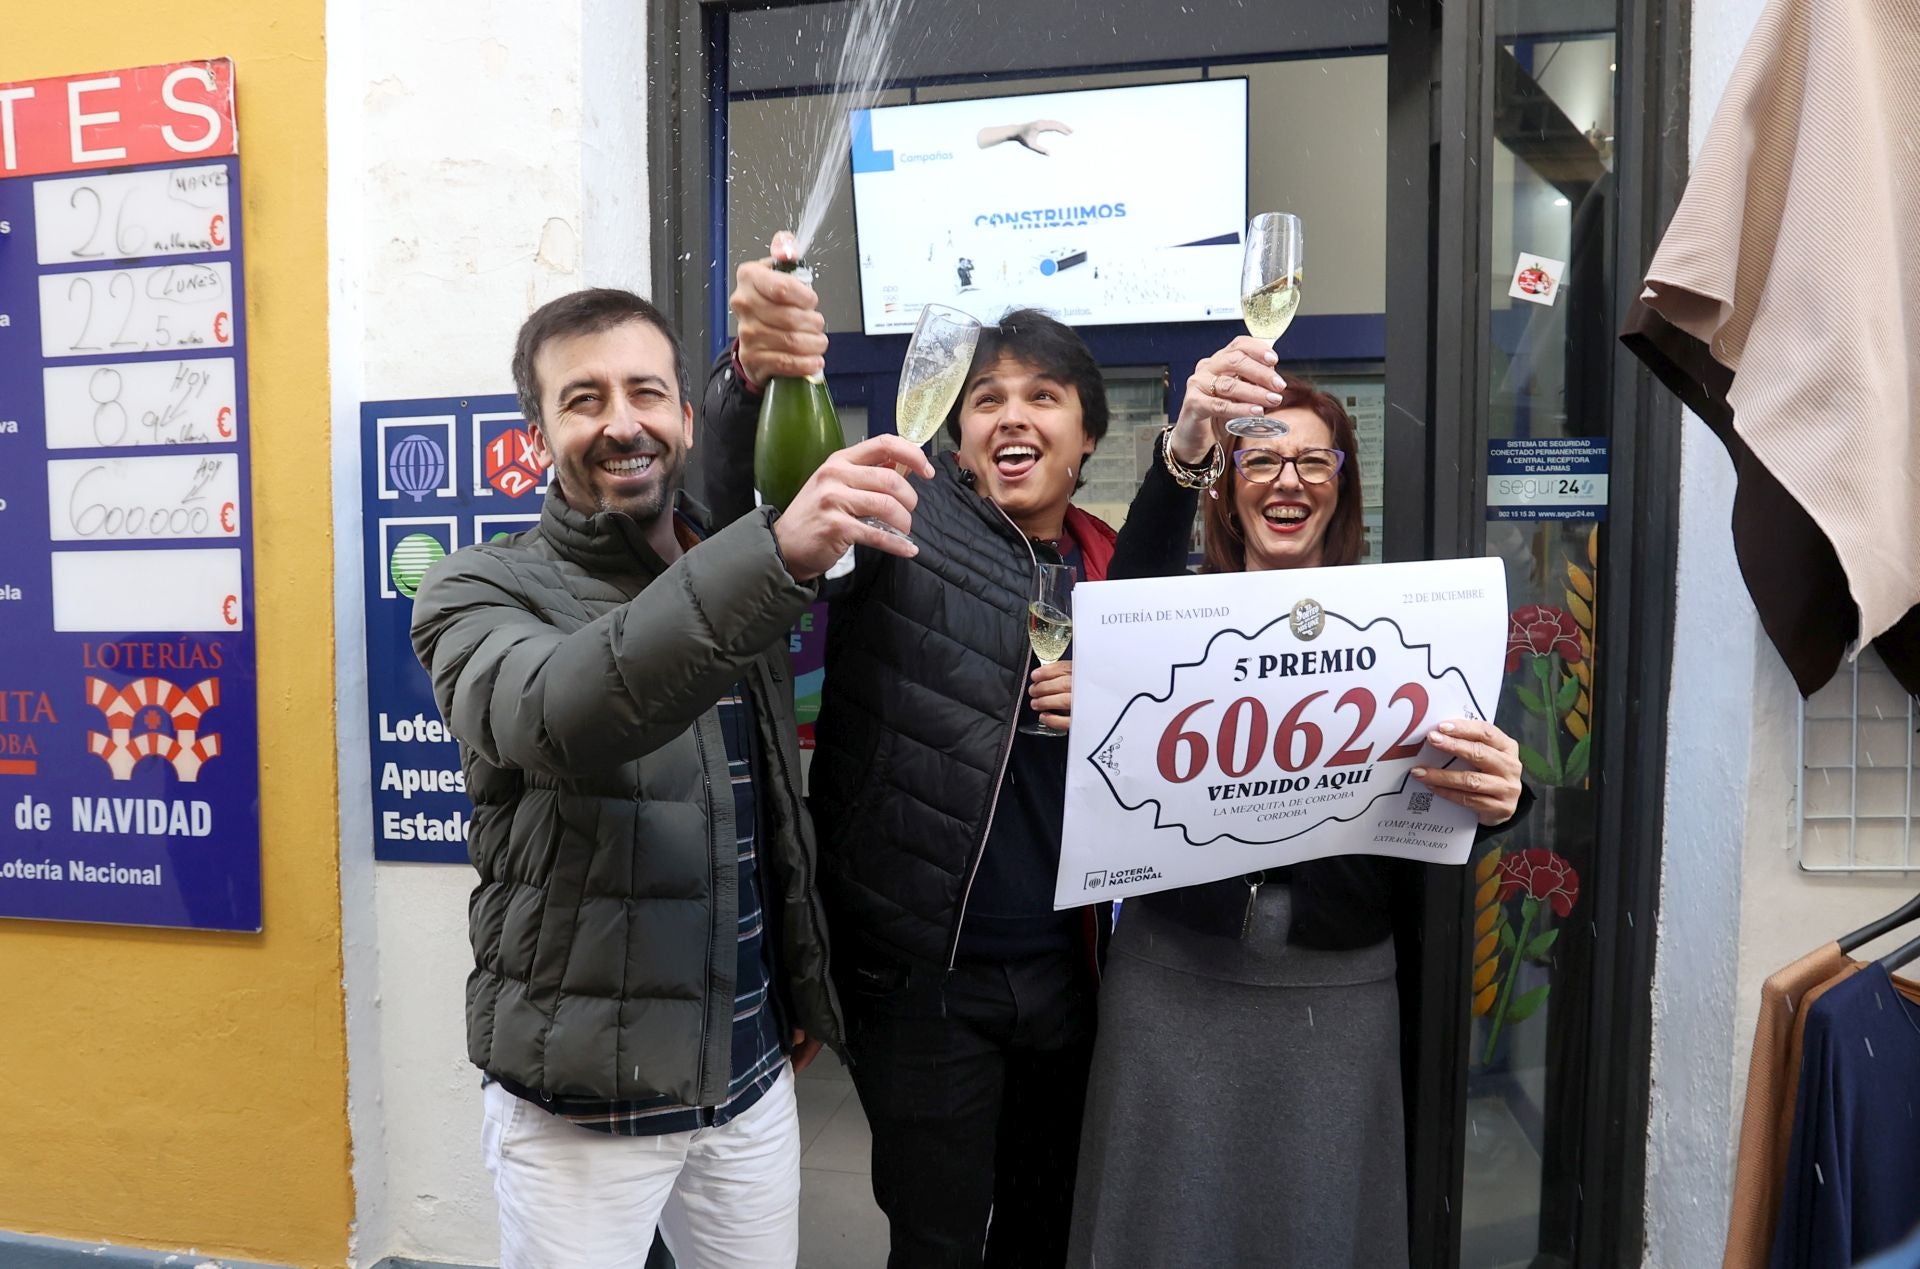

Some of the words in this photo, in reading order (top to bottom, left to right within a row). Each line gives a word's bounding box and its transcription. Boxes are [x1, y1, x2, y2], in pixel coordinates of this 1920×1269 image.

[0, 66, 222, 170] TES
[900, 150, 954, 163] Campañas
[69, 185, 147, 257] 26
[209, 214, 225, 246] €
[214, 311, 229, 343] €
[217, 406, 232, 438] €
[1507, 440, 1537, 448] SISTEMA
[492, 438, 504, 468] 1
[500, 470, 533, 495] 2
[220, 502, 235, 533] €
[1538, 510, 1595, 519] www.segur24.es
[222, 594, 237, 626] €
[1402, 593, 1414, 604] 22
[1415, 592, 1430, 603] DE
[1431, 588, 1486, 602] DICIEMBRE
[1101, 608, 1153, 625] LOTERÍA
[1156, 609, 1172, 622] DE
[1175, 605, 1230, 621] NAVIDAD
[82, 636, 223, 670] LOTERÍAS
[1257, 646, 1377, 679] PREMIO
[1156, 681, 1430, 785] 60622
[1207, 776, 1310, 801] VENDIDO
[1314, 764, 1374, 790] AQUÍ
[15, 795, 51, 831] de
[72, 796, 212, 837] NAVIDAD
[1213, 807, 1227, 817] LA
[1230, 800, 1286, 815] MEZQUITA
[1289, 798, 1303, 808] DE
[1305, 791, 1355, 805] CORDOBA
[1256, 808, 1308, 823] CORDOBA
[1373, 835, 1448, 850] EXTRAORDINARIO
[1377, 819, 1454, 835] COMPARTIRLO
[68, 860, 163, 886] Nacional
[1108, 872, 1163, 886] NACIONAL
[1110, 865, 1154, 879] LOTERÍA
